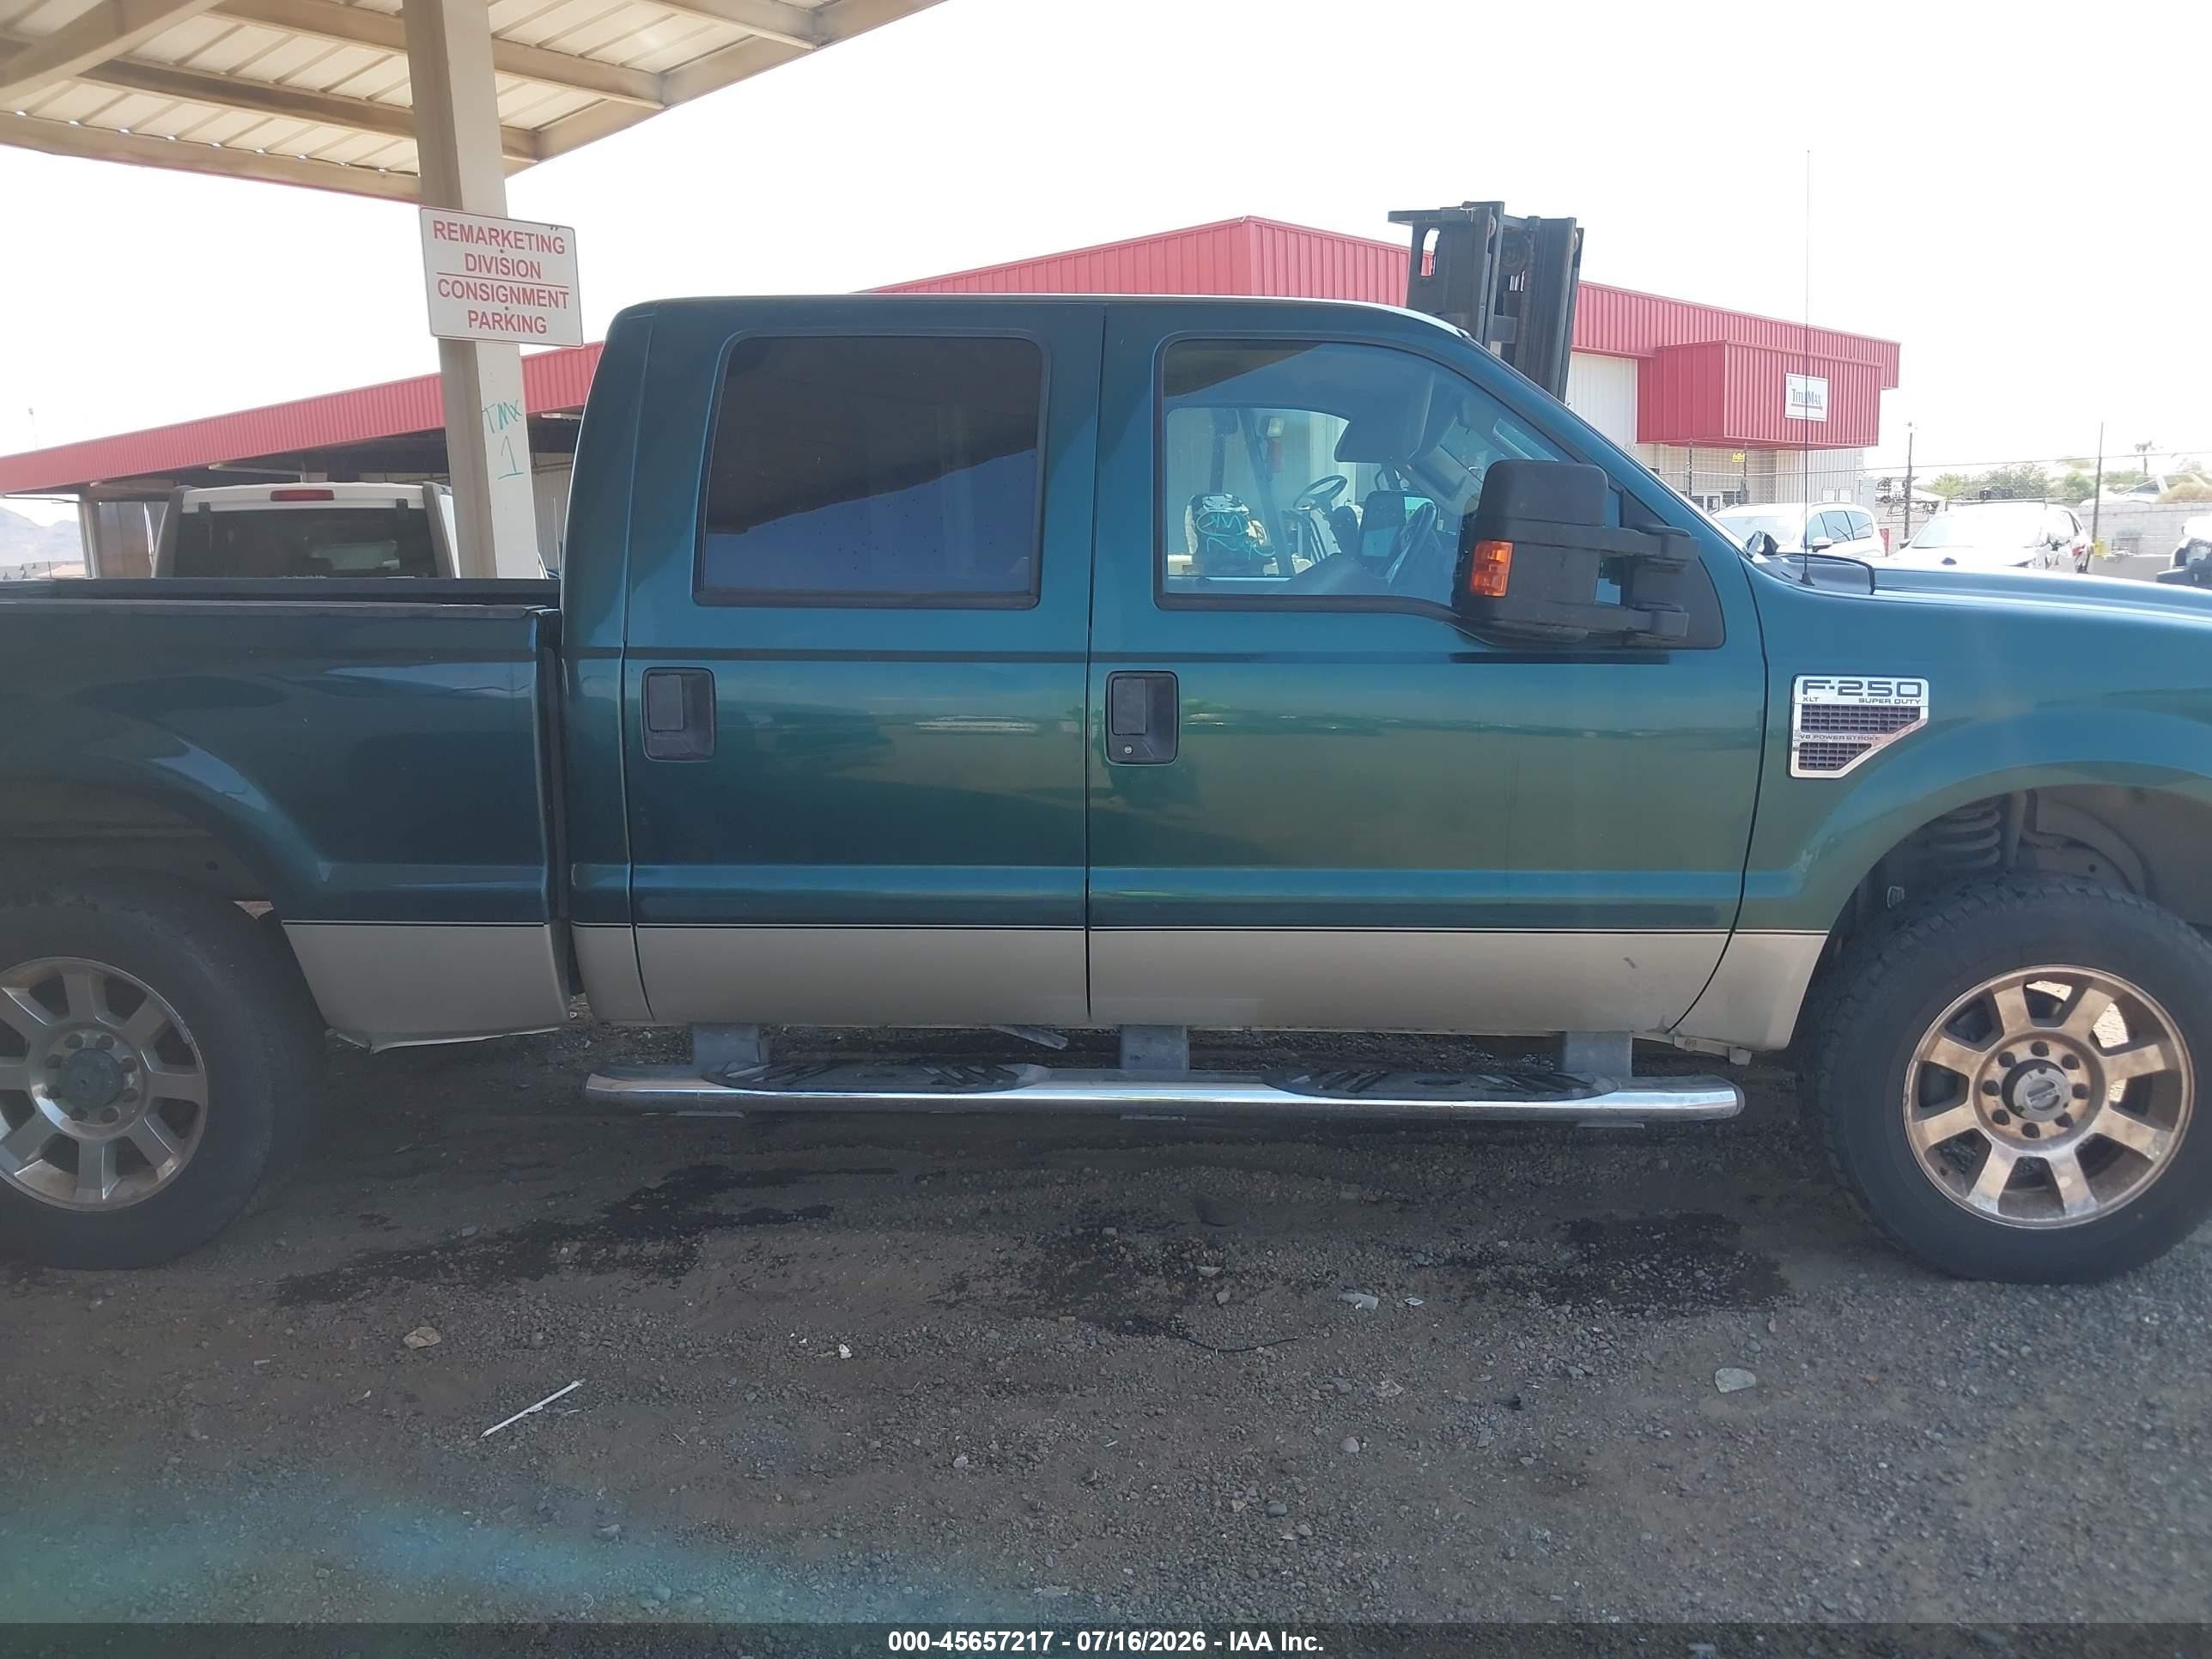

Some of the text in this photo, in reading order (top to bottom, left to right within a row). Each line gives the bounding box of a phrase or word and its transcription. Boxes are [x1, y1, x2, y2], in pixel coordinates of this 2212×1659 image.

[433, 220, 565, 254] REMARKETING
[465, 252, 542, 280] DIVISION
[437, 278, 570, 310] CONSIGNMENT
[467, 309, 548, 335] PARKING
[498, 435, 525, 480] 1
[1802, 679, 1922, 697] F-250
